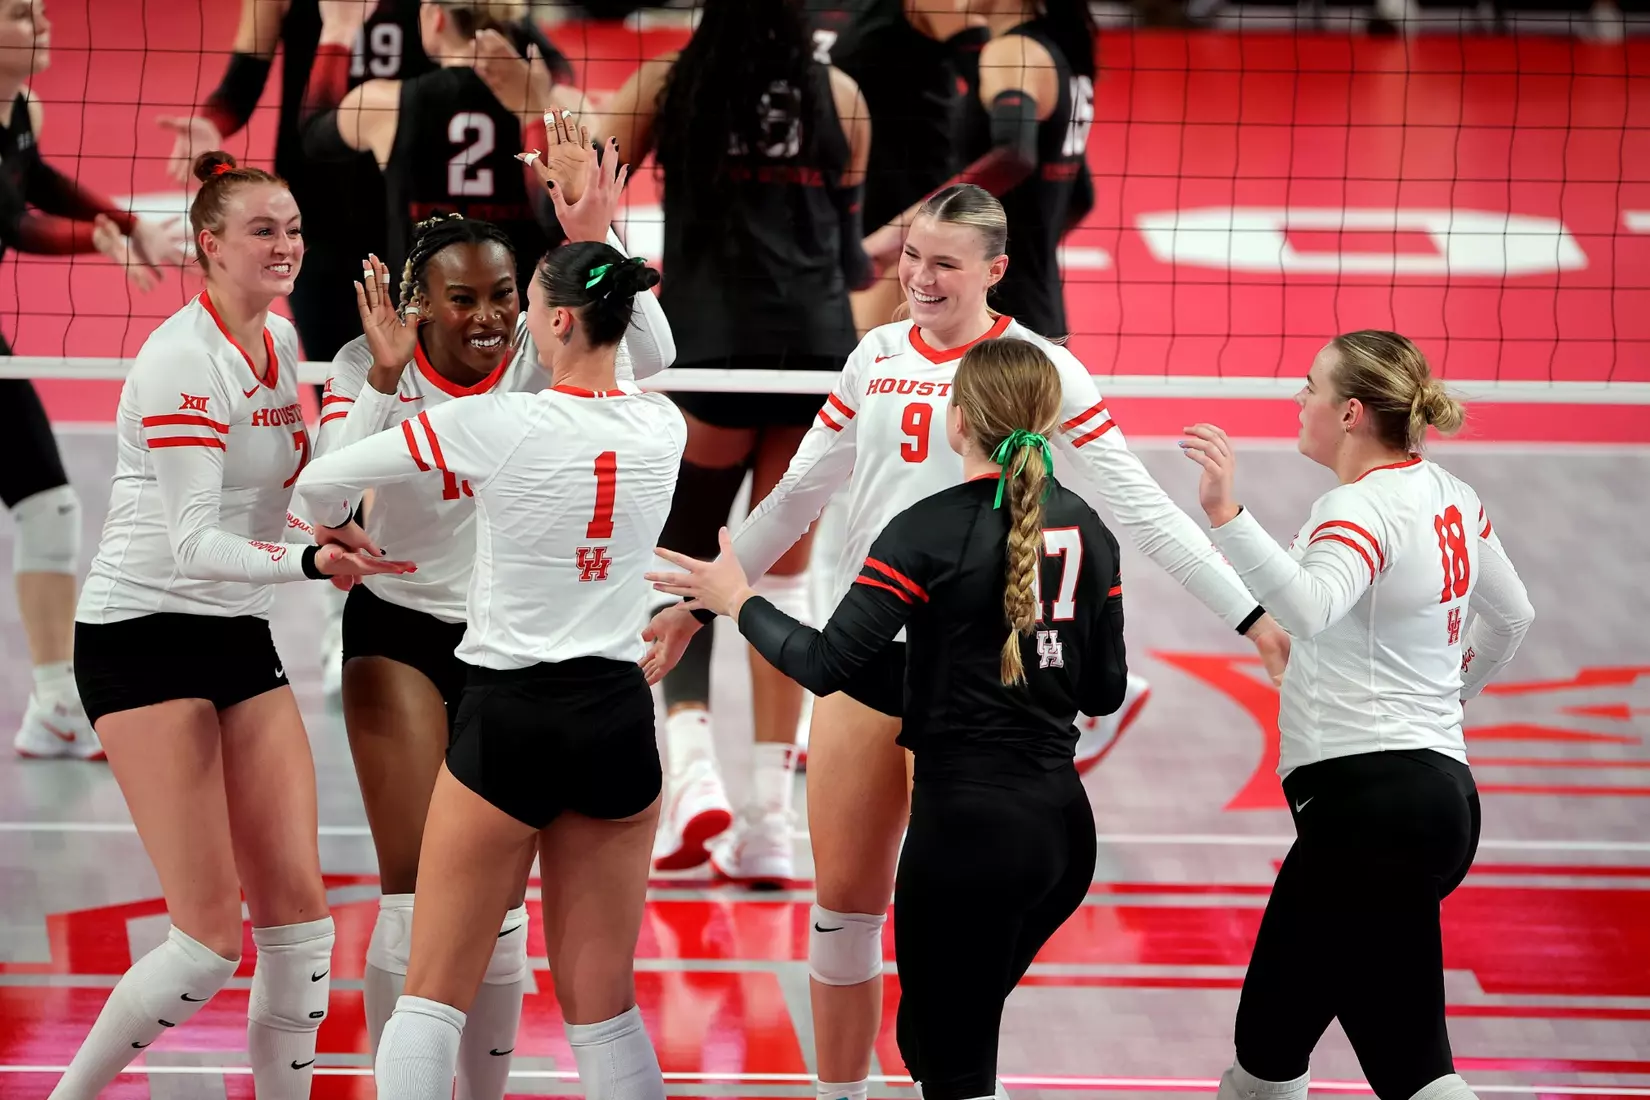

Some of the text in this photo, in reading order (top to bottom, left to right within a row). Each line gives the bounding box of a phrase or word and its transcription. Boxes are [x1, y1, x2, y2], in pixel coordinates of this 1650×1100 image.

[447, 111, 495, 197] 2
[179, 393, 210, 414] XII
[900, 402, 933, 463] 9
[283, 430, 312, 489] 7
[286, 512, 314, 536] ugars
[586, 450, 617, 539] 1
[576, 546, 612, 582] UH
[1434, 504, 1471, 604] 18
[1036, 629, 1064, 669] UH
